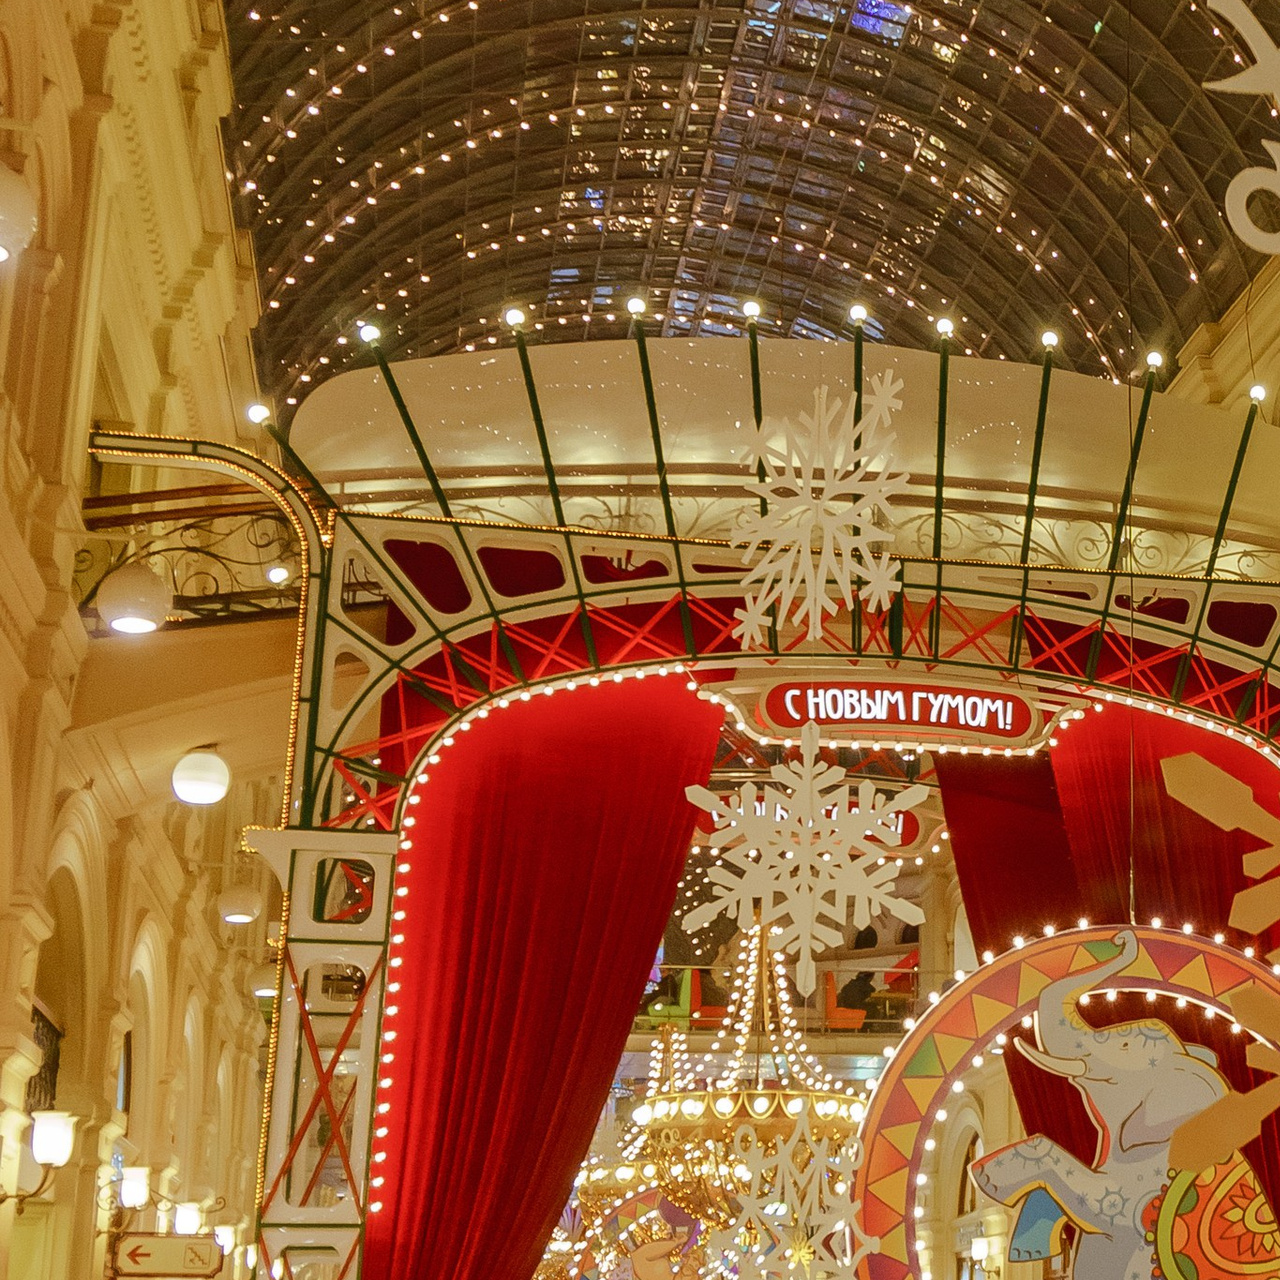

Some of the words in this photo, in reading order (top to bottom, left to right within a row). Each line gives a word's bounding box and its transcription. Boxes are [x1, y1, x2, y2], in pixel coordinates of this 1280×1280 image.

[784, 689, 801, 720] С
[806, 689, 906, 721] НОВЫМ
[911, 691, 1014, 731] ГУМОМ!
